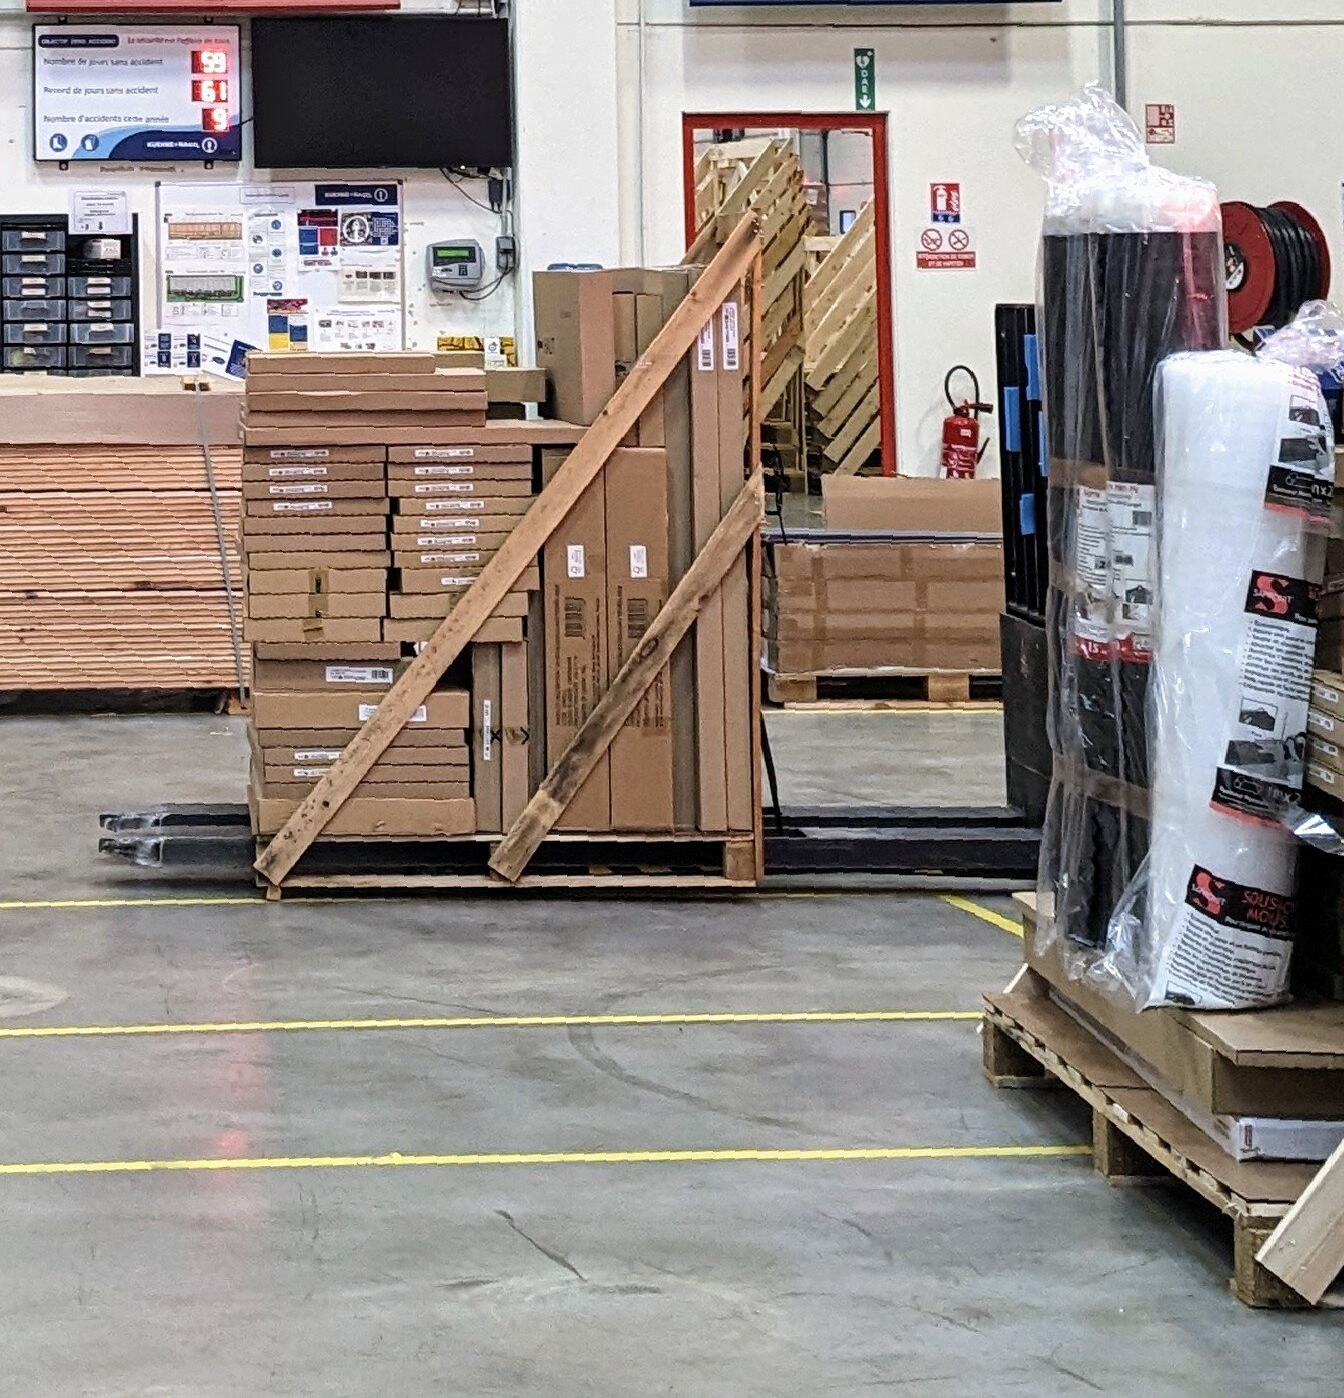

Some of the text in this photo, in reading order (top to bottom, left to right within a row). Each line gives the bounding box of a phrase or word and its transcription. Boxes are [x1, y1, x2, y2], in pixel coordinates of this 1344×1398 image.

[43, 57, 75, 66] Nombre
[77, 57, 87, 66] de
[130, 57, 163, 66] accident
[44, 86, 71, 95] Record
[73, 86, 82, 95] de
[84, 86, 104, 96] jours
[126, 85, 159, 95] accident
[201, 80, 226, 102] 61
[44, 114, 76, 123] Nombre
[78, 113, 122, 123] d'accidents
[213, 108, 227, 130] 9
